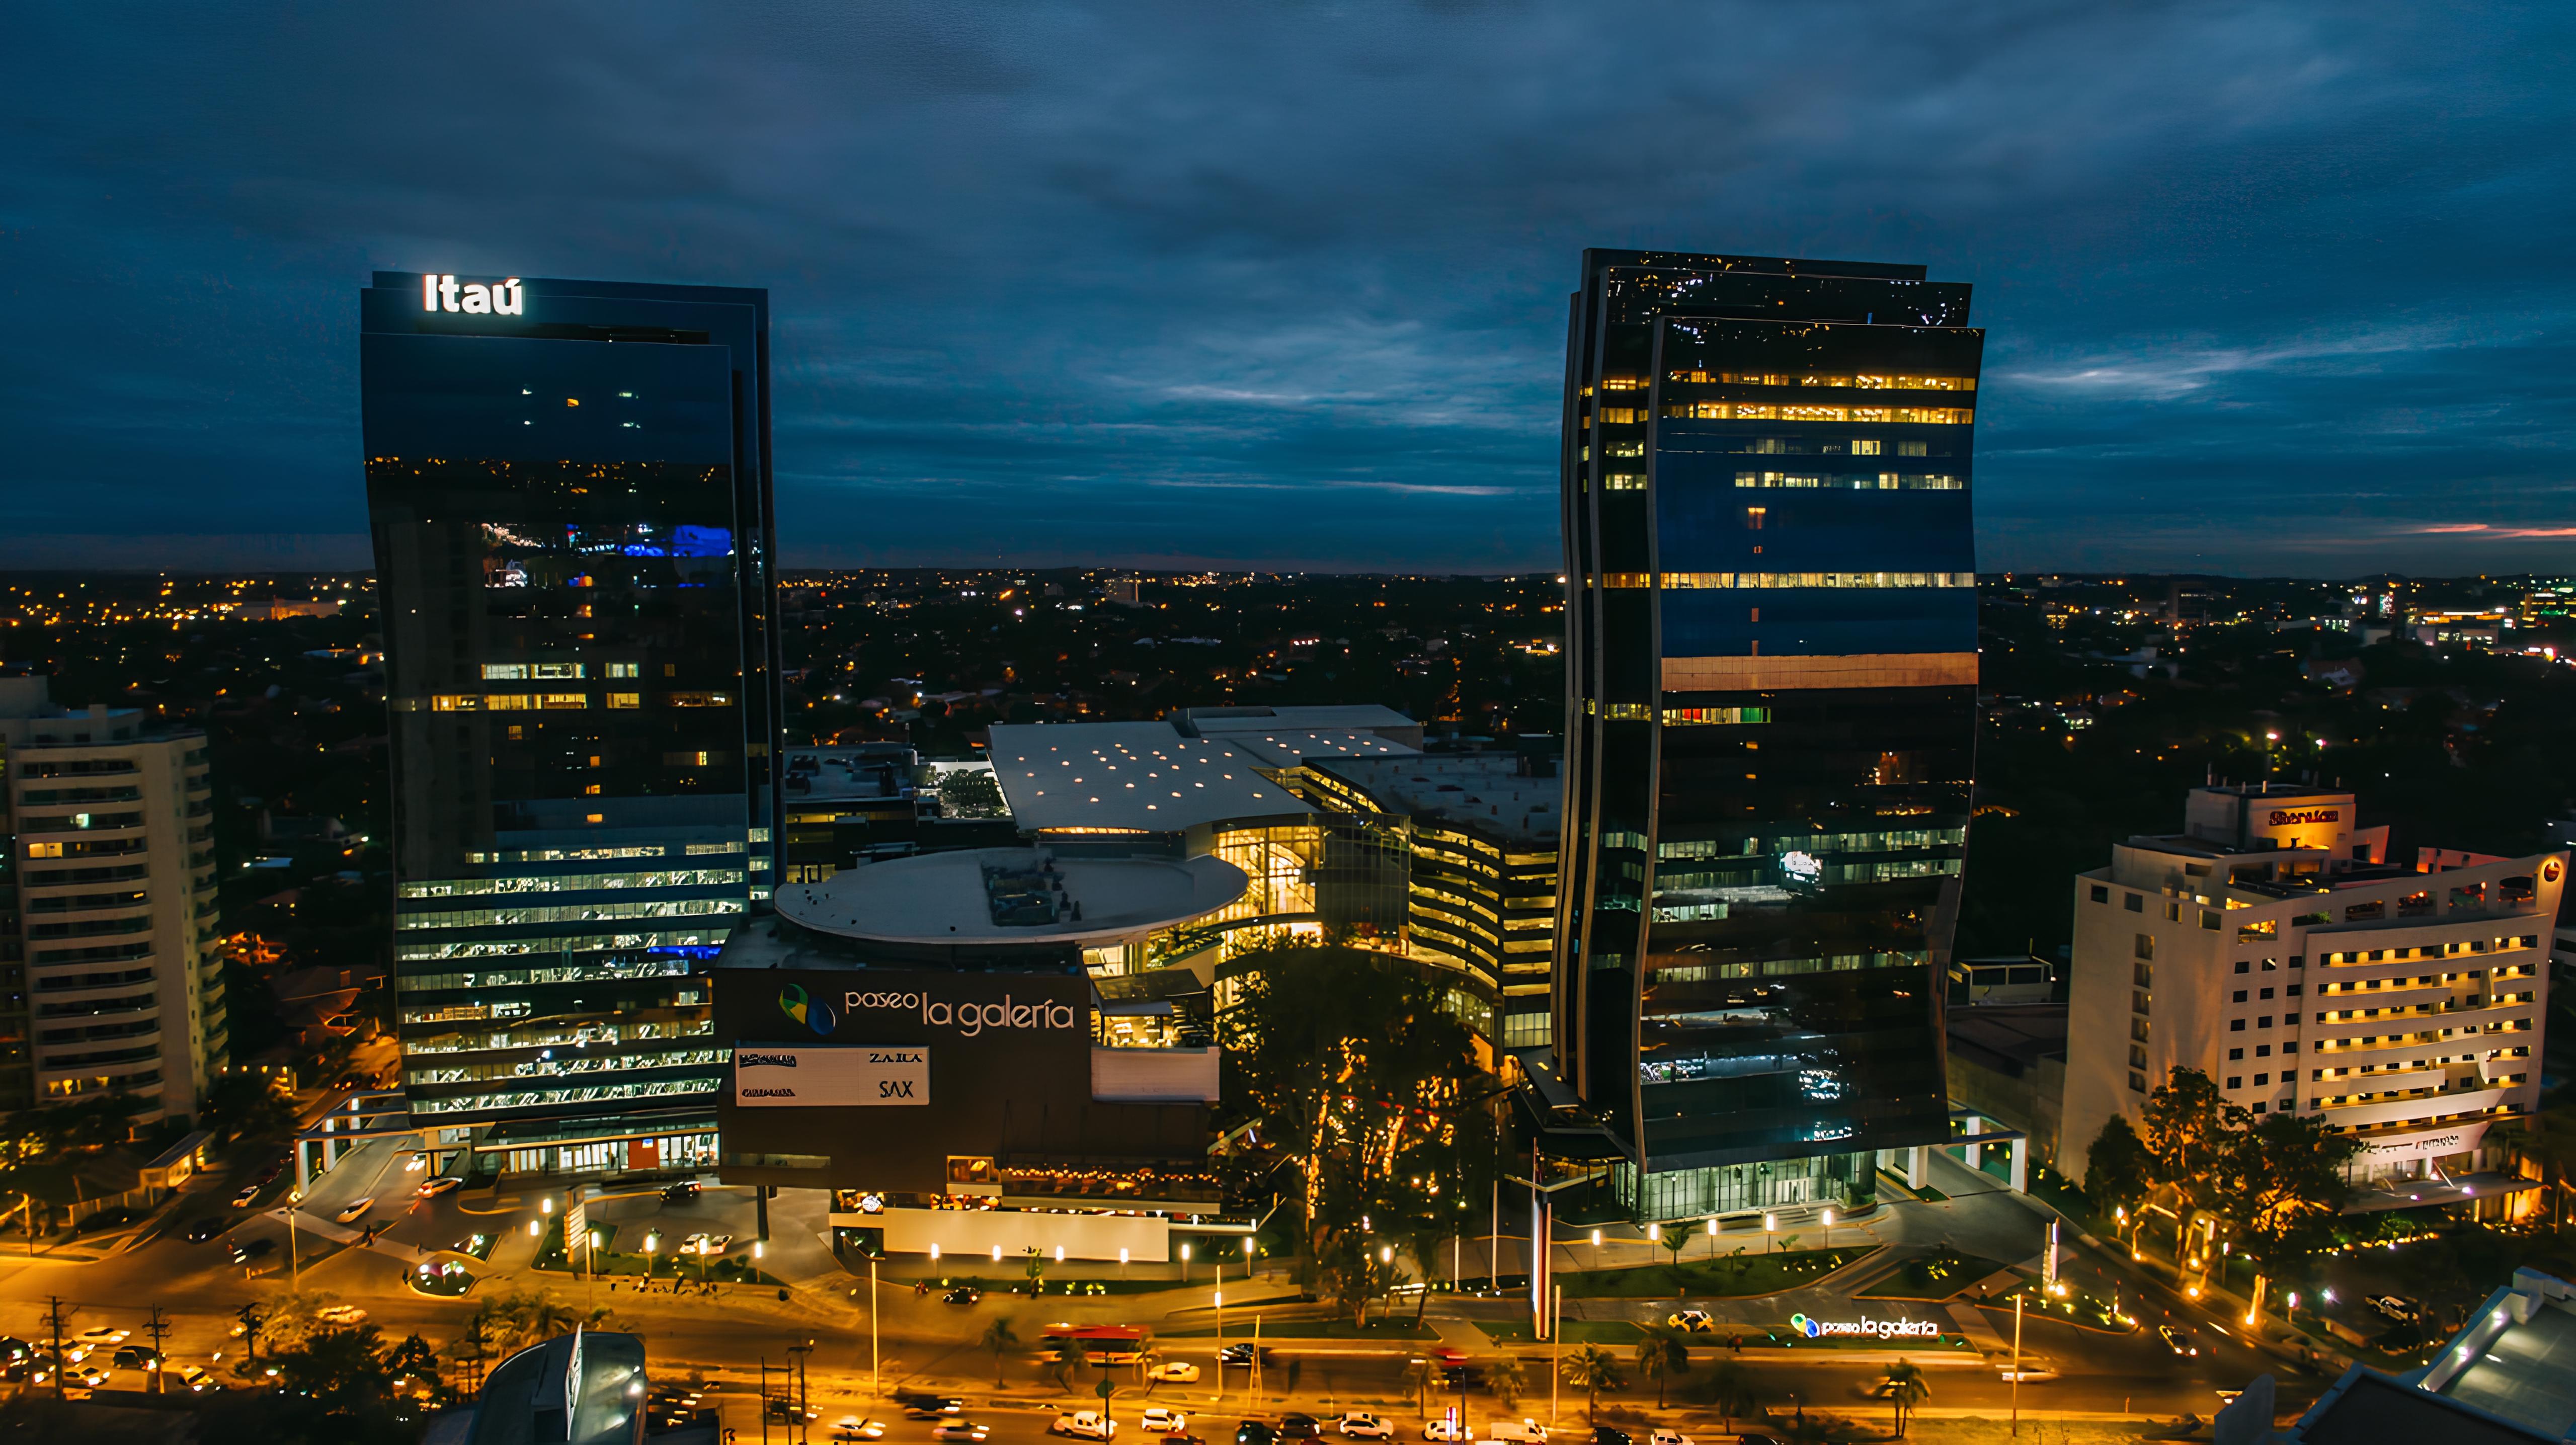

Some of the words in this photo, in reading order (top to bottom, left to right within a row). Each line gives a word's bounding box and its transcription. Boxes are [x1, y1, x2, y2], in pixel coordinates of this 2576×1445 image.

[424, 274, 522, 315] Itaú
[845, 991, 919, 1014] paseo
[922, 992, 952, 1025] la
[958, 994, 1074, 1037] galería
[879, 1081, 914, 1098] SAX
[1861, 1315, 1877, 1333] la
